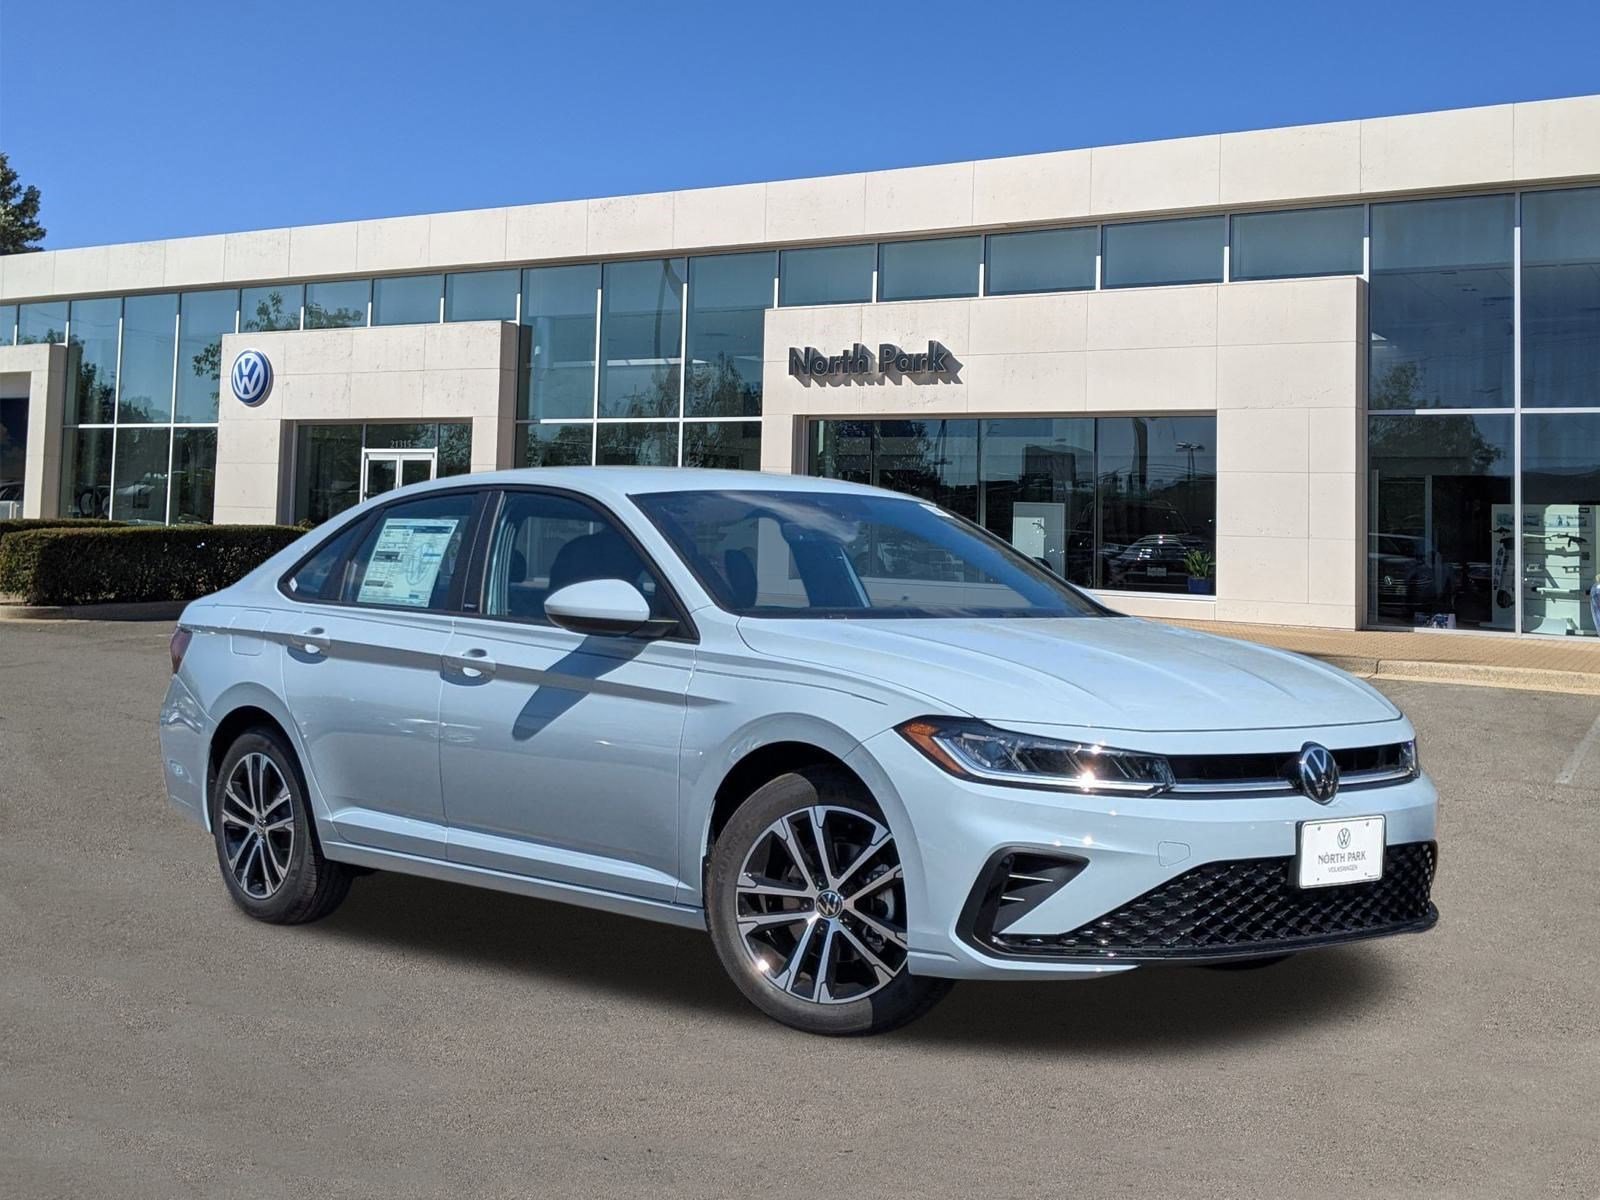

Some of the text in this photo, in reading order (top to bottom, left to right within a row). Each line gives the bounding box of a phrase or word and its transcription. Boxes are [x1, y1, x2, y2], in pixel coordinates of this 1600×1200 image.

[789, 340, 948, 376] North Park
[1318, 850, 1367, 864] NORTH PARK
